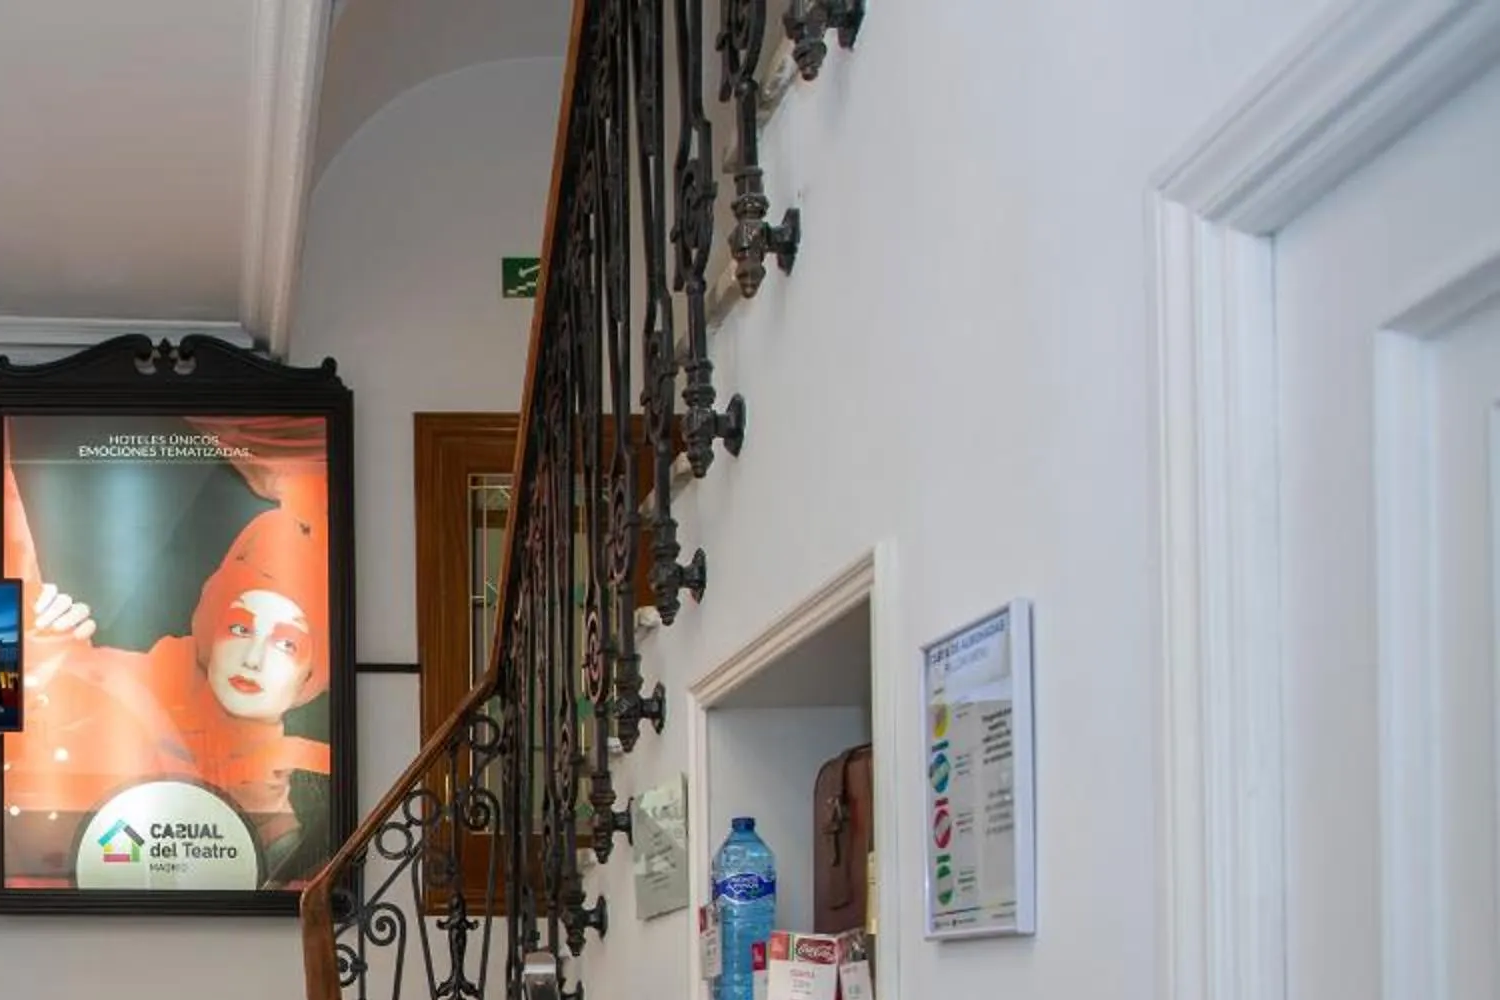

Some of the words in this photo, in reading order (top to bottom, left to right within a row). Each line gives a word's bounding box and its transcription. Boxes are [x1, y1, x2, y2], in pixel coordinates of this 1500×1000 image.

[109, 434, 166, 446] HOTELES
[78, 446, 157, 458] EMOCIONES
[150, 823, 224, 840] CASUAL
[149, 842, 178, 859] del
[181, 842, 238, 859] Teatro
